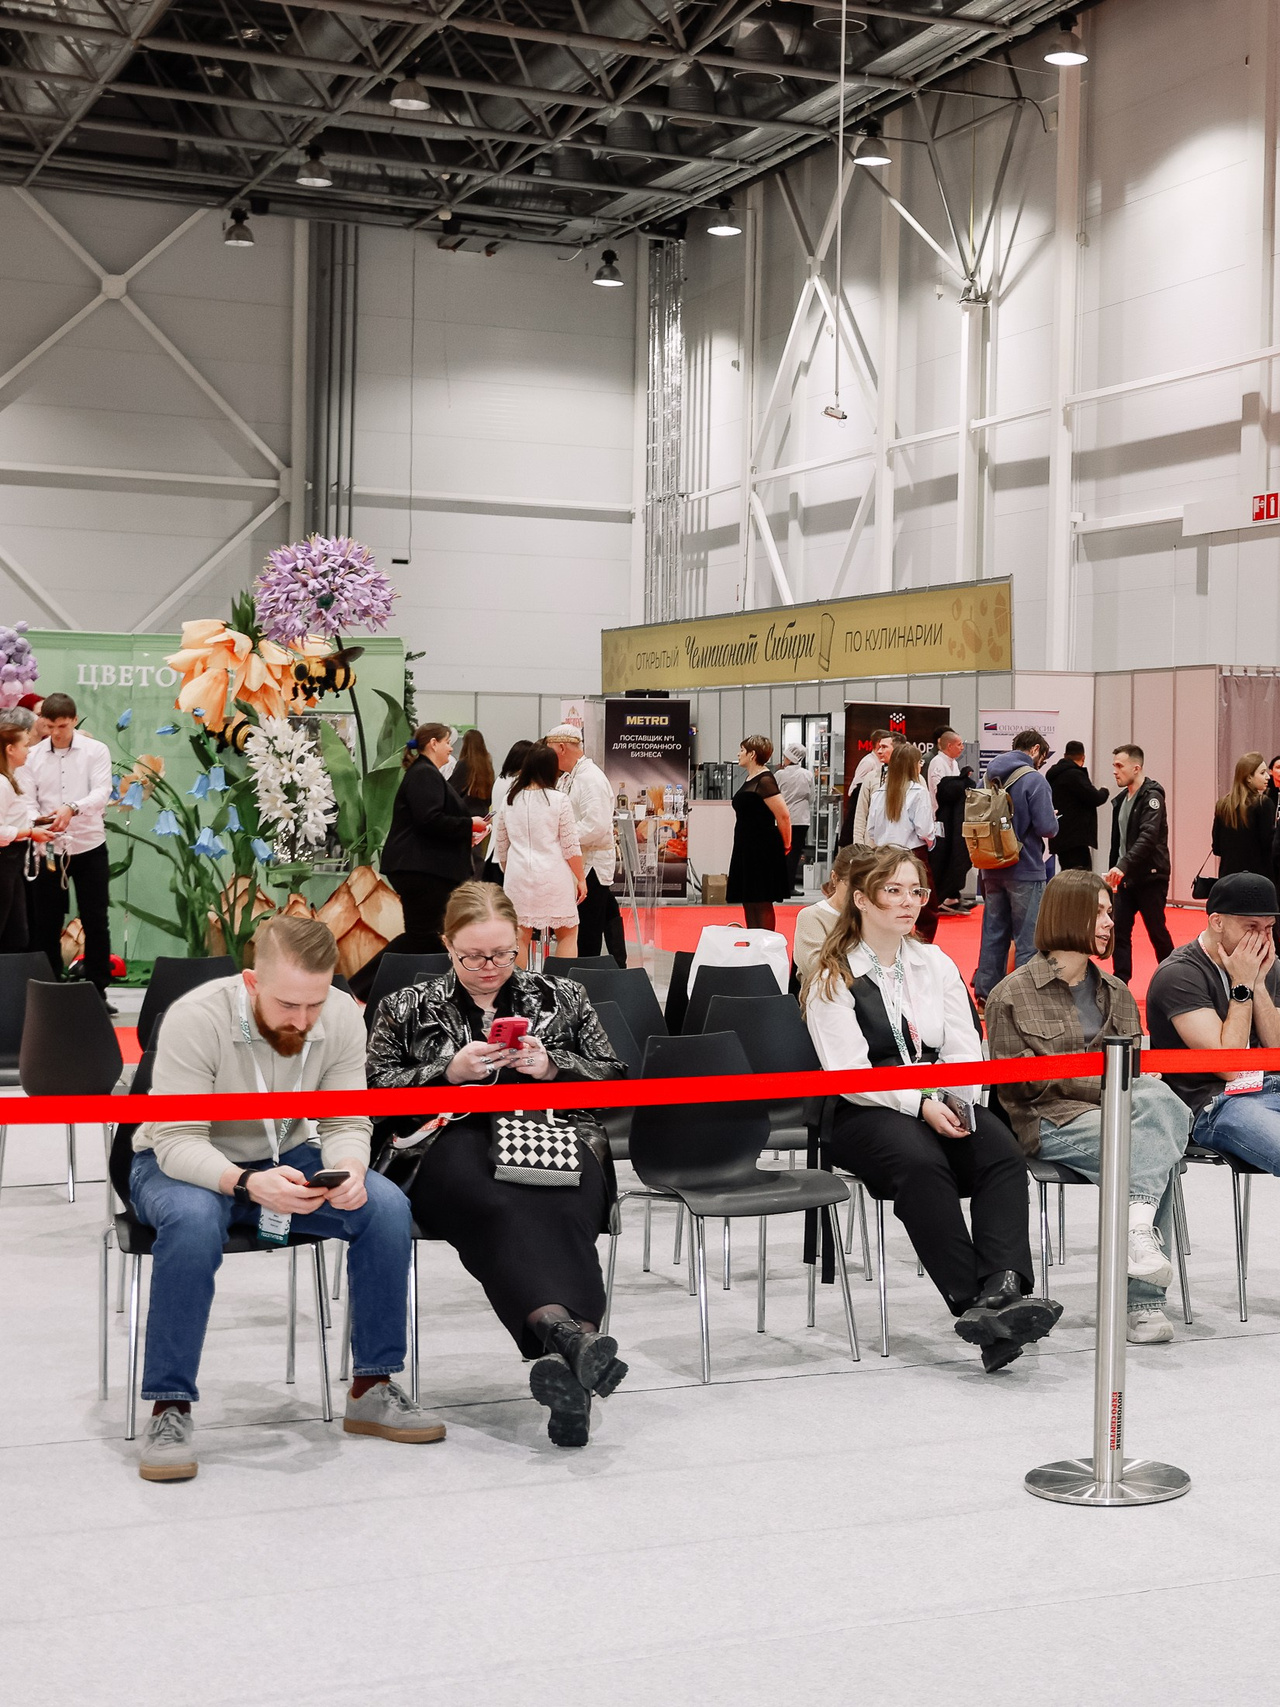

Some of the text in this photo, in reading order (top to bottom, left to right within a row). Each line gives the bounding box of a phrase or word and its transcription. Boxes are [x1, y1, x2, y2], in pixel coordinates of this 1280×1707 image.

[635, 619, 943, 674] ОТКРЫТЫЙ Чемпионат Сибири ПО КУЛИНАРИИ
[76, 663, 187, 690] ЦВЕТО
[626, 715, 669, 725] METRO
[620, 734, 663, 742] ПОСТАВЩИК
